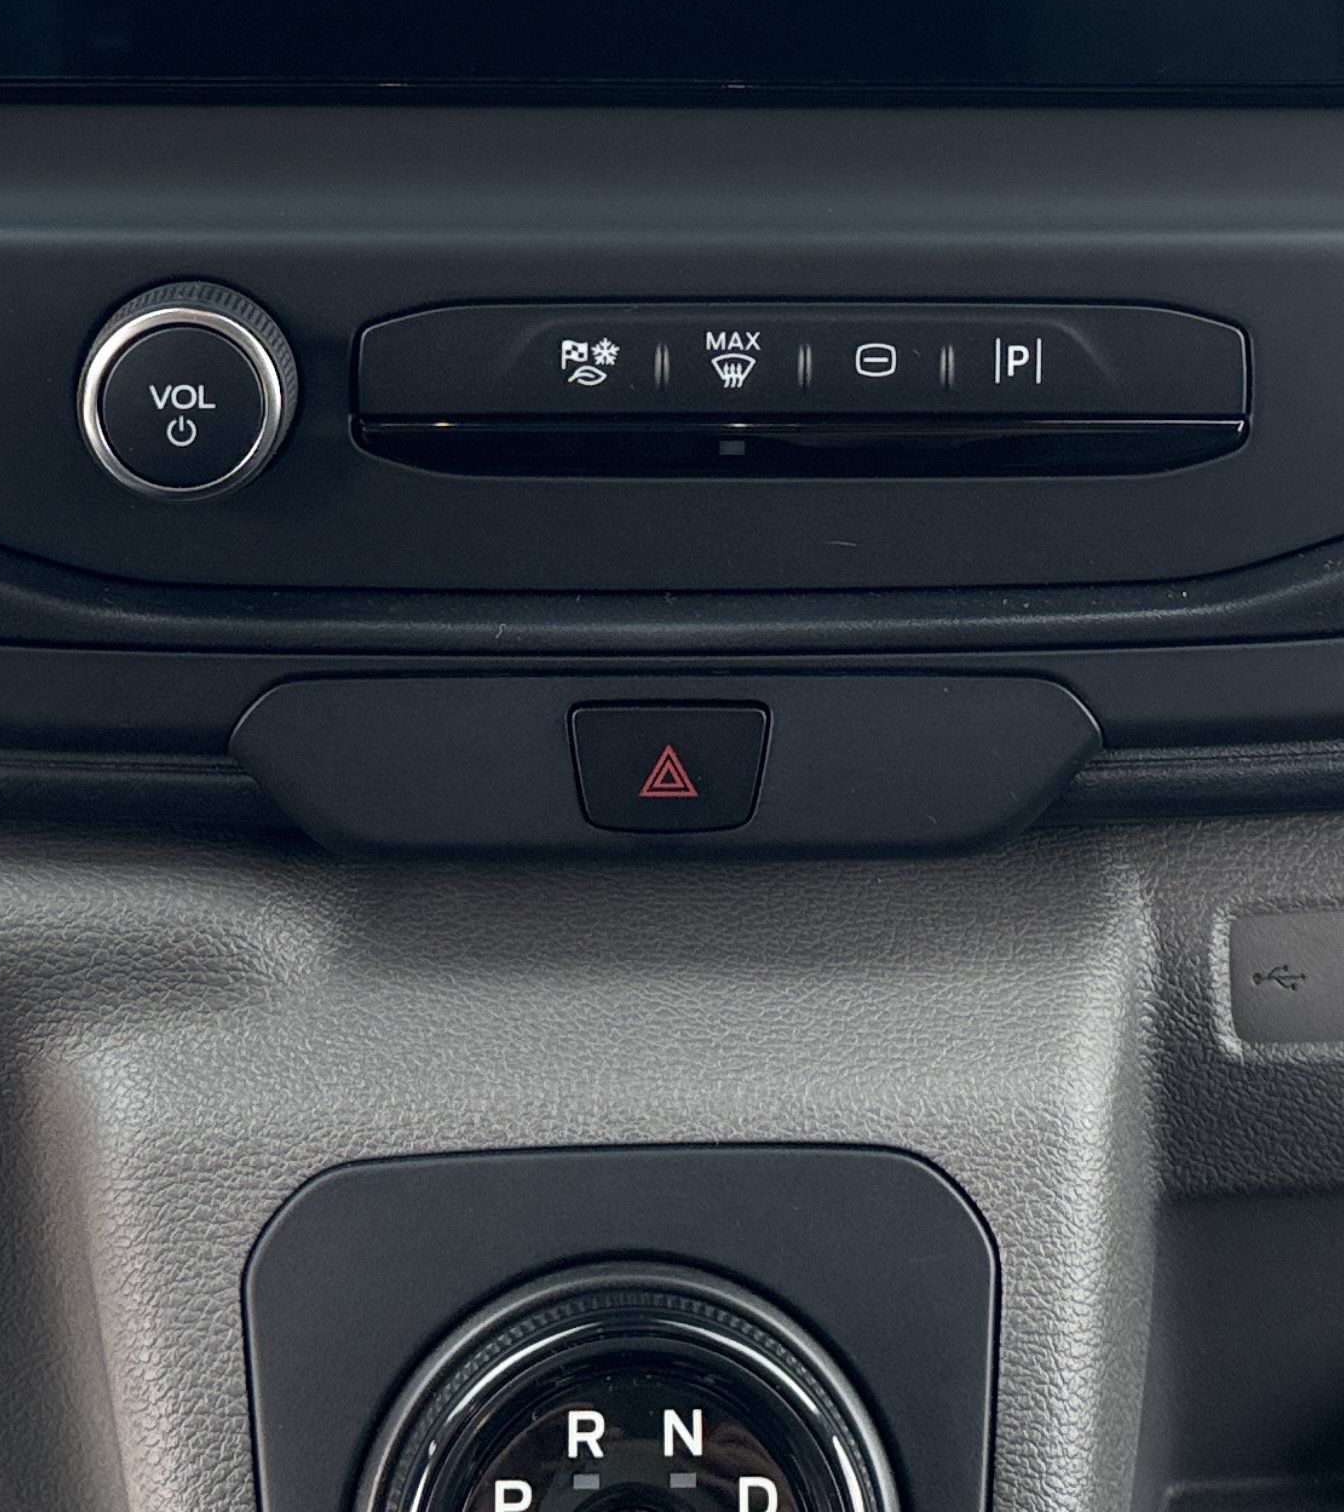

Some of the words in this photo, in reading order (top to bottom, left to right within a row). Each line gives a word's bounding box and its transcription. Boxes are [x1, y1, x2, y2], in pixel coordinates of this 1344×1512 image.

[705, 331, 761, 352] MAX
[149, 384, 216, 411] VOL
[567, 1410, 606, 1458] R
[662, 1408, 704, 1457] N
[494, 1479, 533, 1512] P
[738, 1476, 778, 1512] D
